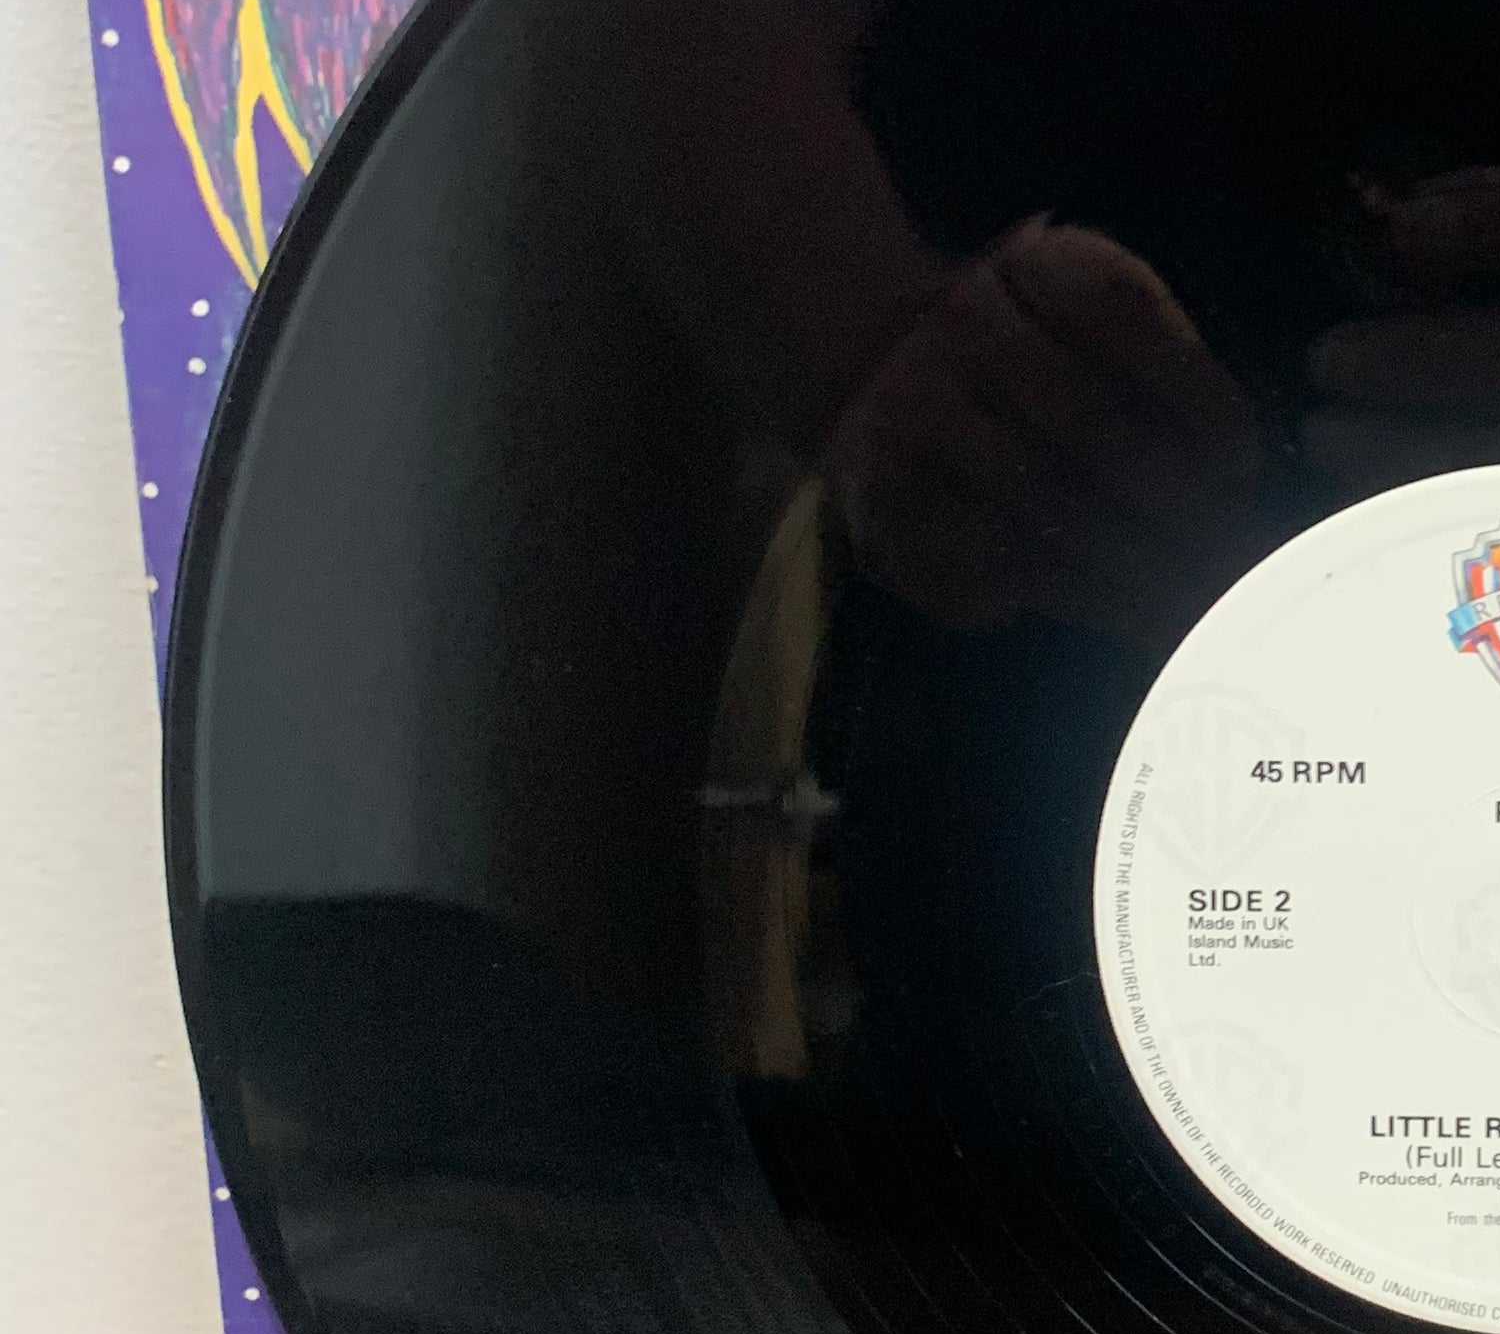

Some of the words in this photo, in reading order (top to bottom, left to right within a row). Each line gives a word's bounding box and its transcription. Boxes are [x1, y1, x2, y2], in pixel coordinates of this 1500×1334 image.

[1135, 762, 1153, 786] ALL
[1250, 760, 1284, 784] 45
[1293, 760, 1366, 785] RPM
[1121, 790, 1146, 840] RIGHTS
[1118, 841, 1134, 859] OF
[1115, 860, 1133, 886] THE
[1188, 888, 1263, 913] SIDE
[1274, 889, 1292, 913] 2
[1188, 915, 1235, 931] Made
[1241, 915, 1256, 931] in
[1263, 916, 1289, 931] UK
[1114, 890, 1141, 1003] MANUFACTURER
[1188, 934, 1237, 950] Island
[1244, 934, 1294, 950] Music
[1188, 953, 1221, 968] Ltd.
[1130, 1004, 1150, 1035] AND
[1139, 1035, 1156, 1054] OF
[1147, 1054, 1168, 1079] THE
[1158, 1079, 1192, 1129] OWNER
[1187, 1126, 1205, 1145] OF
[1370, 1115, 1472, 1139] LITTLE
[1200, 1142, 1221, 1166] THE
[1405, 1144, 1463, 1170] (Full
[1217, 1163, 1274, 1221] RECORDED
[1358, 1171, 1443, 1188] Produced,
[1447, 1211, 1478, 1226] From
[1273, 1216, 1311, 1250] WORK
[1311, 1242, 1375, 1284] RESERVED
[1382, 1279, 1487, 1318] UNAUTHORISED
